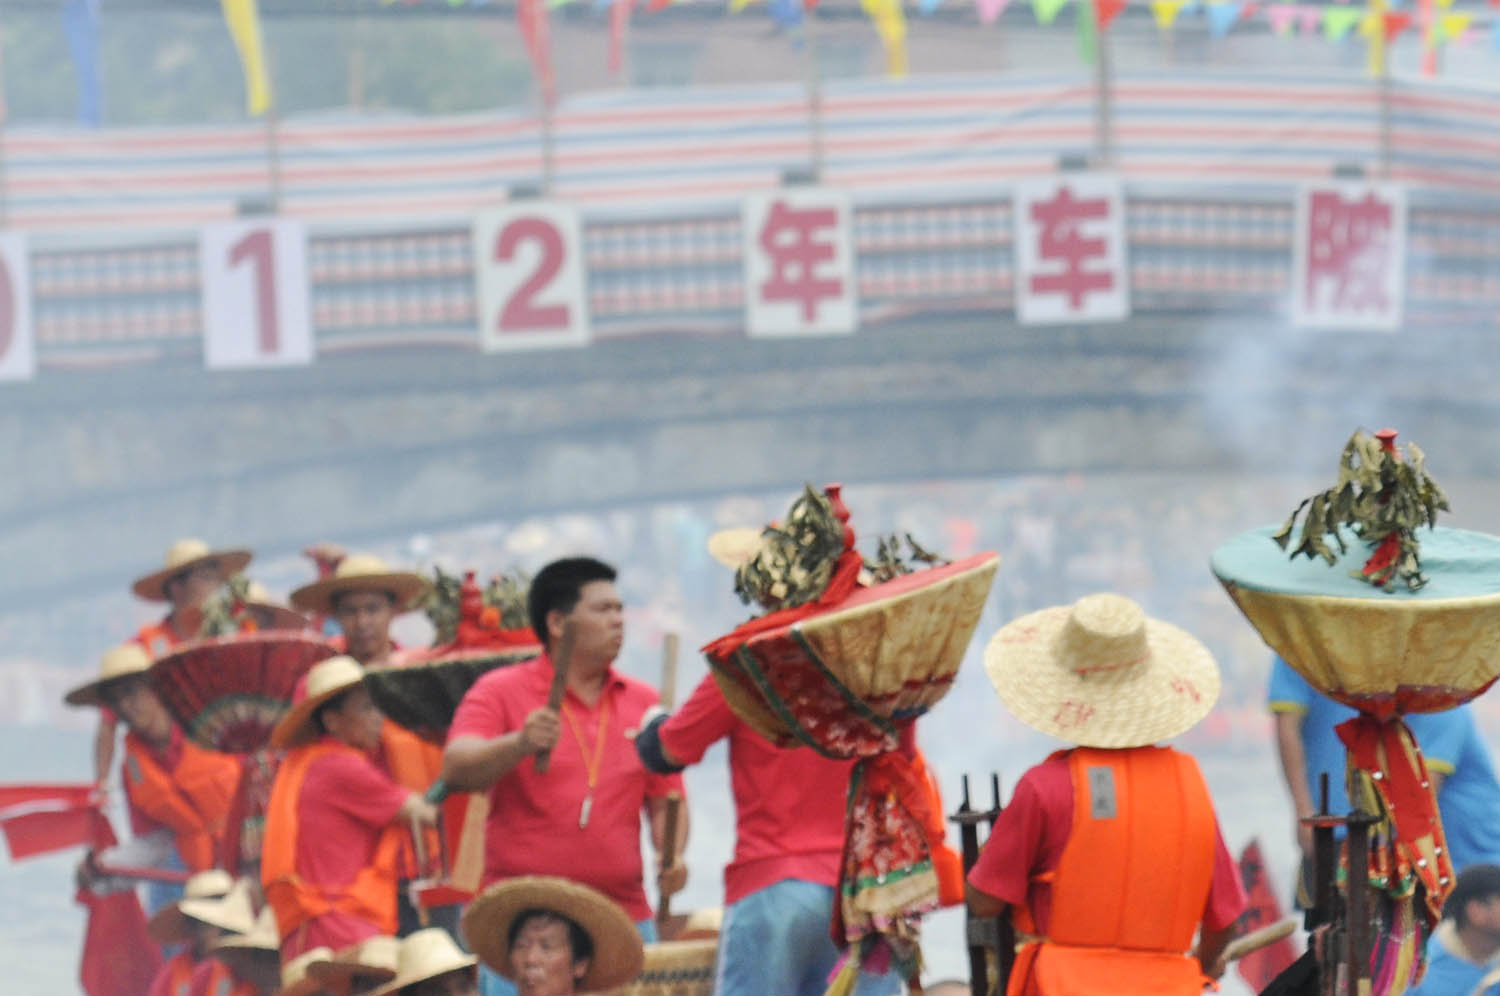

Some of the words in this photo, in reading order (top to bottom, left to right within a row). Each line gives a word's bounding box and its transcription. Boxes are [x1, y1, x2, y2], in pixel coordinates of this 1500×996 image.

[227, 229, 280, 353] 1
[494, 217, 569, 332] 2
[760, 201, 843, 322] 年
[1030, 187, 1114, 310] 车
